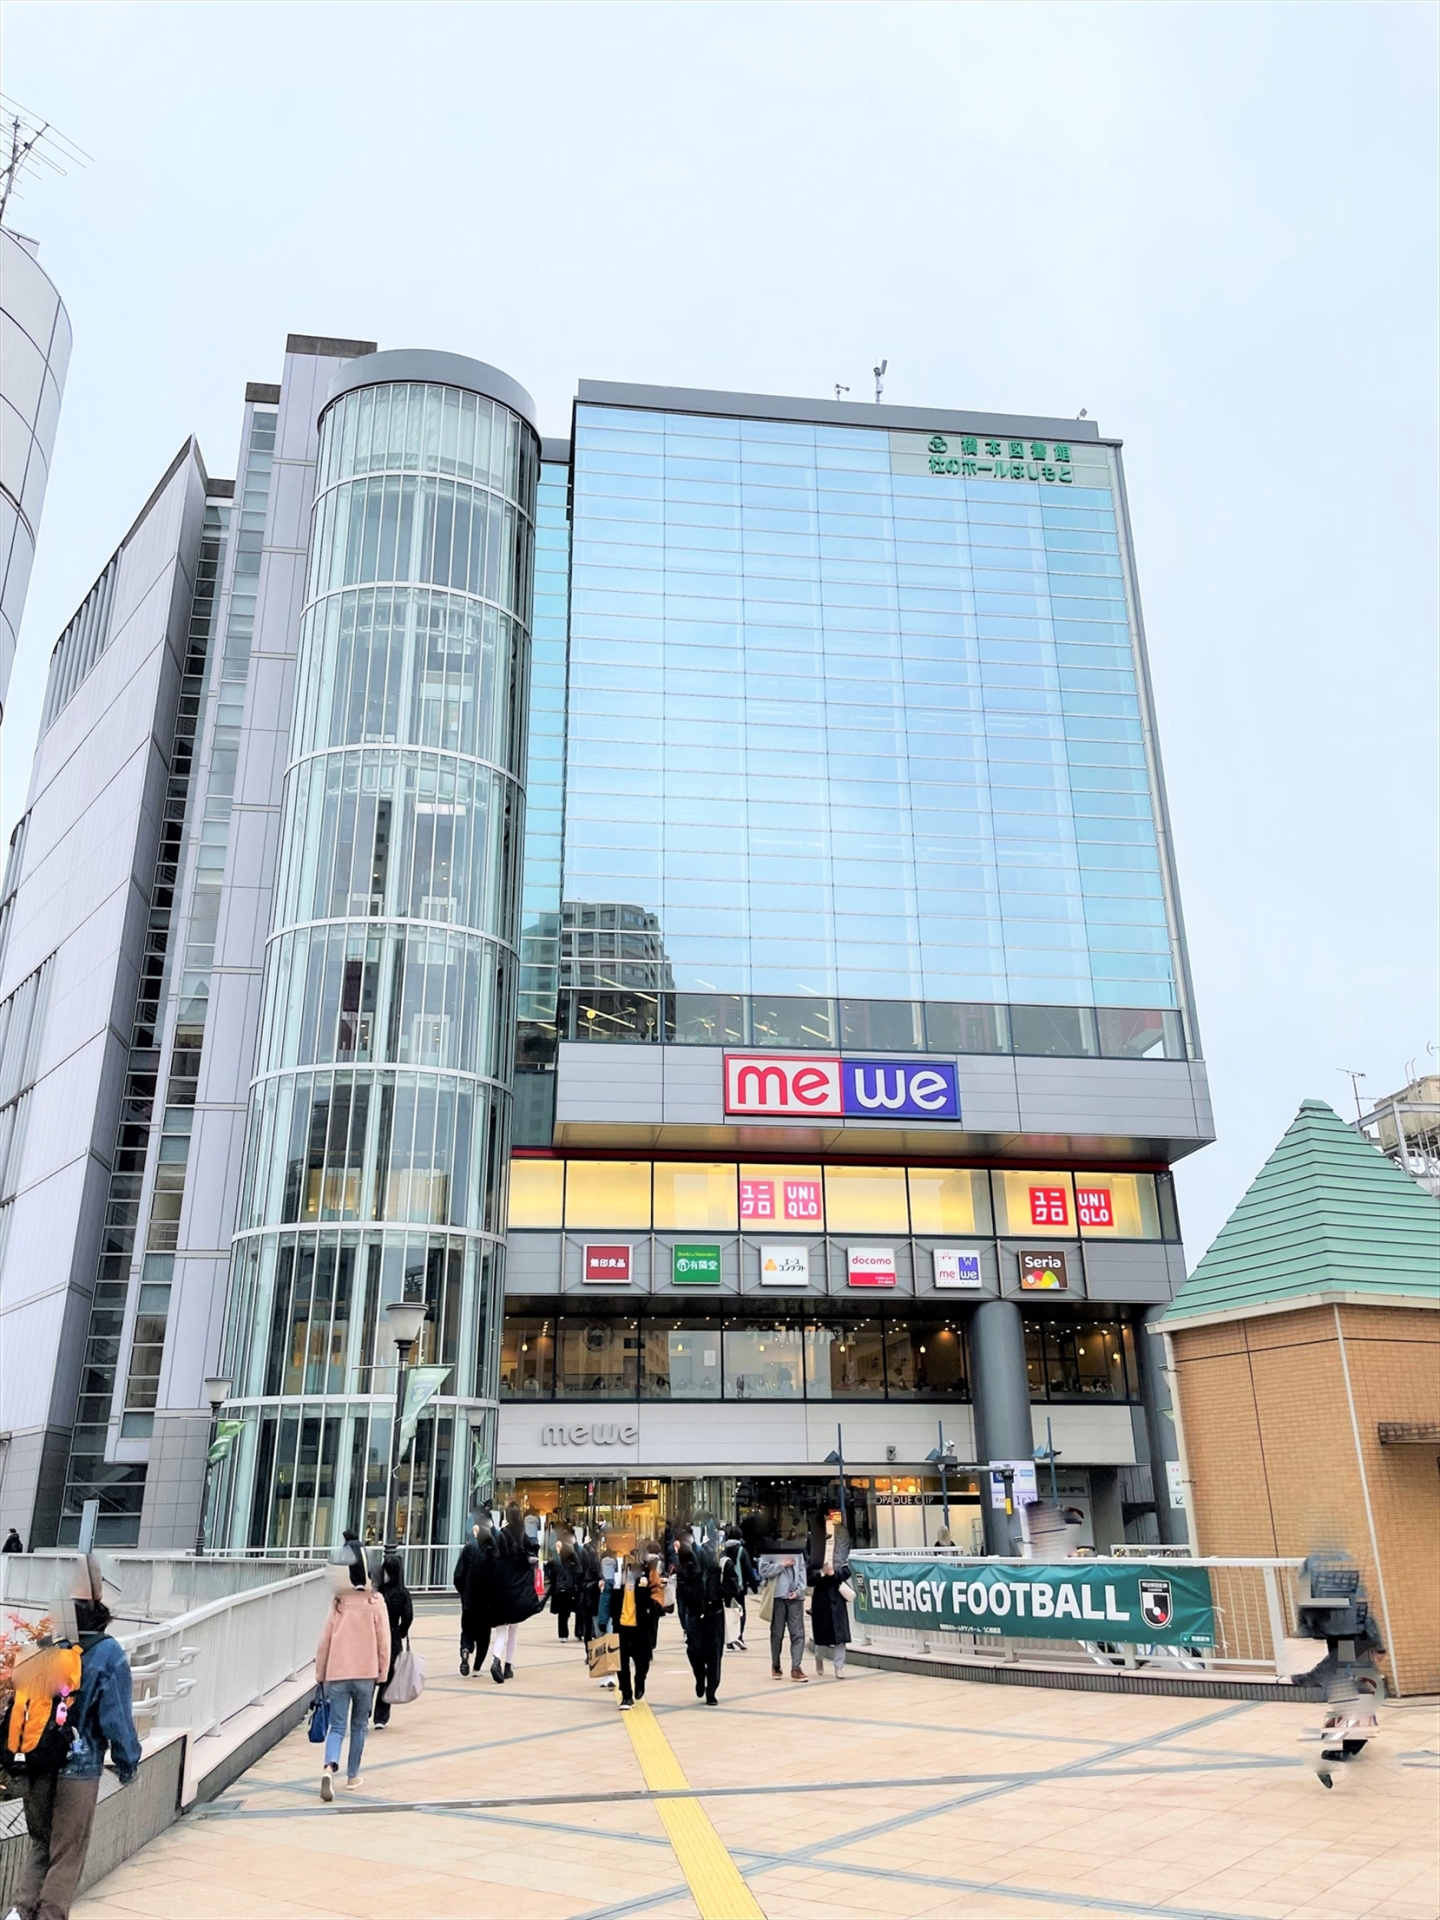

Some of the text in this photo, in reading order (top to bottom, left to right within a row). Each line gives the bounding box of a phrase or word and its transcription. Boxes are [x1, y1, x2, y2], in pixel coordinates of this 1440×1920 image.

[961, 436, 1071, 463] 橋本図書館
[737, 1065, 948, 1111] me we
[787, 1186, 815, 1200] UNI
[1078, 1193, 1105, 1207] UNI
[788, 1201, 818, 1217] QLO
[1080, 1208, 1110, 1224] QLO
[590, 1258, 626, 1268] 無印良品
[690, 1260, 718, 1271] 有隣堂
[852, 1256, 892, 1265] docomo
[1024, 1255, 1062, 1268] Seria
[939, 1270, 978, 1279] me we
[542, 1424, 638, 1446] mewe
[869, 1578, 1130, 1621] ENERGY FOOTBALL
